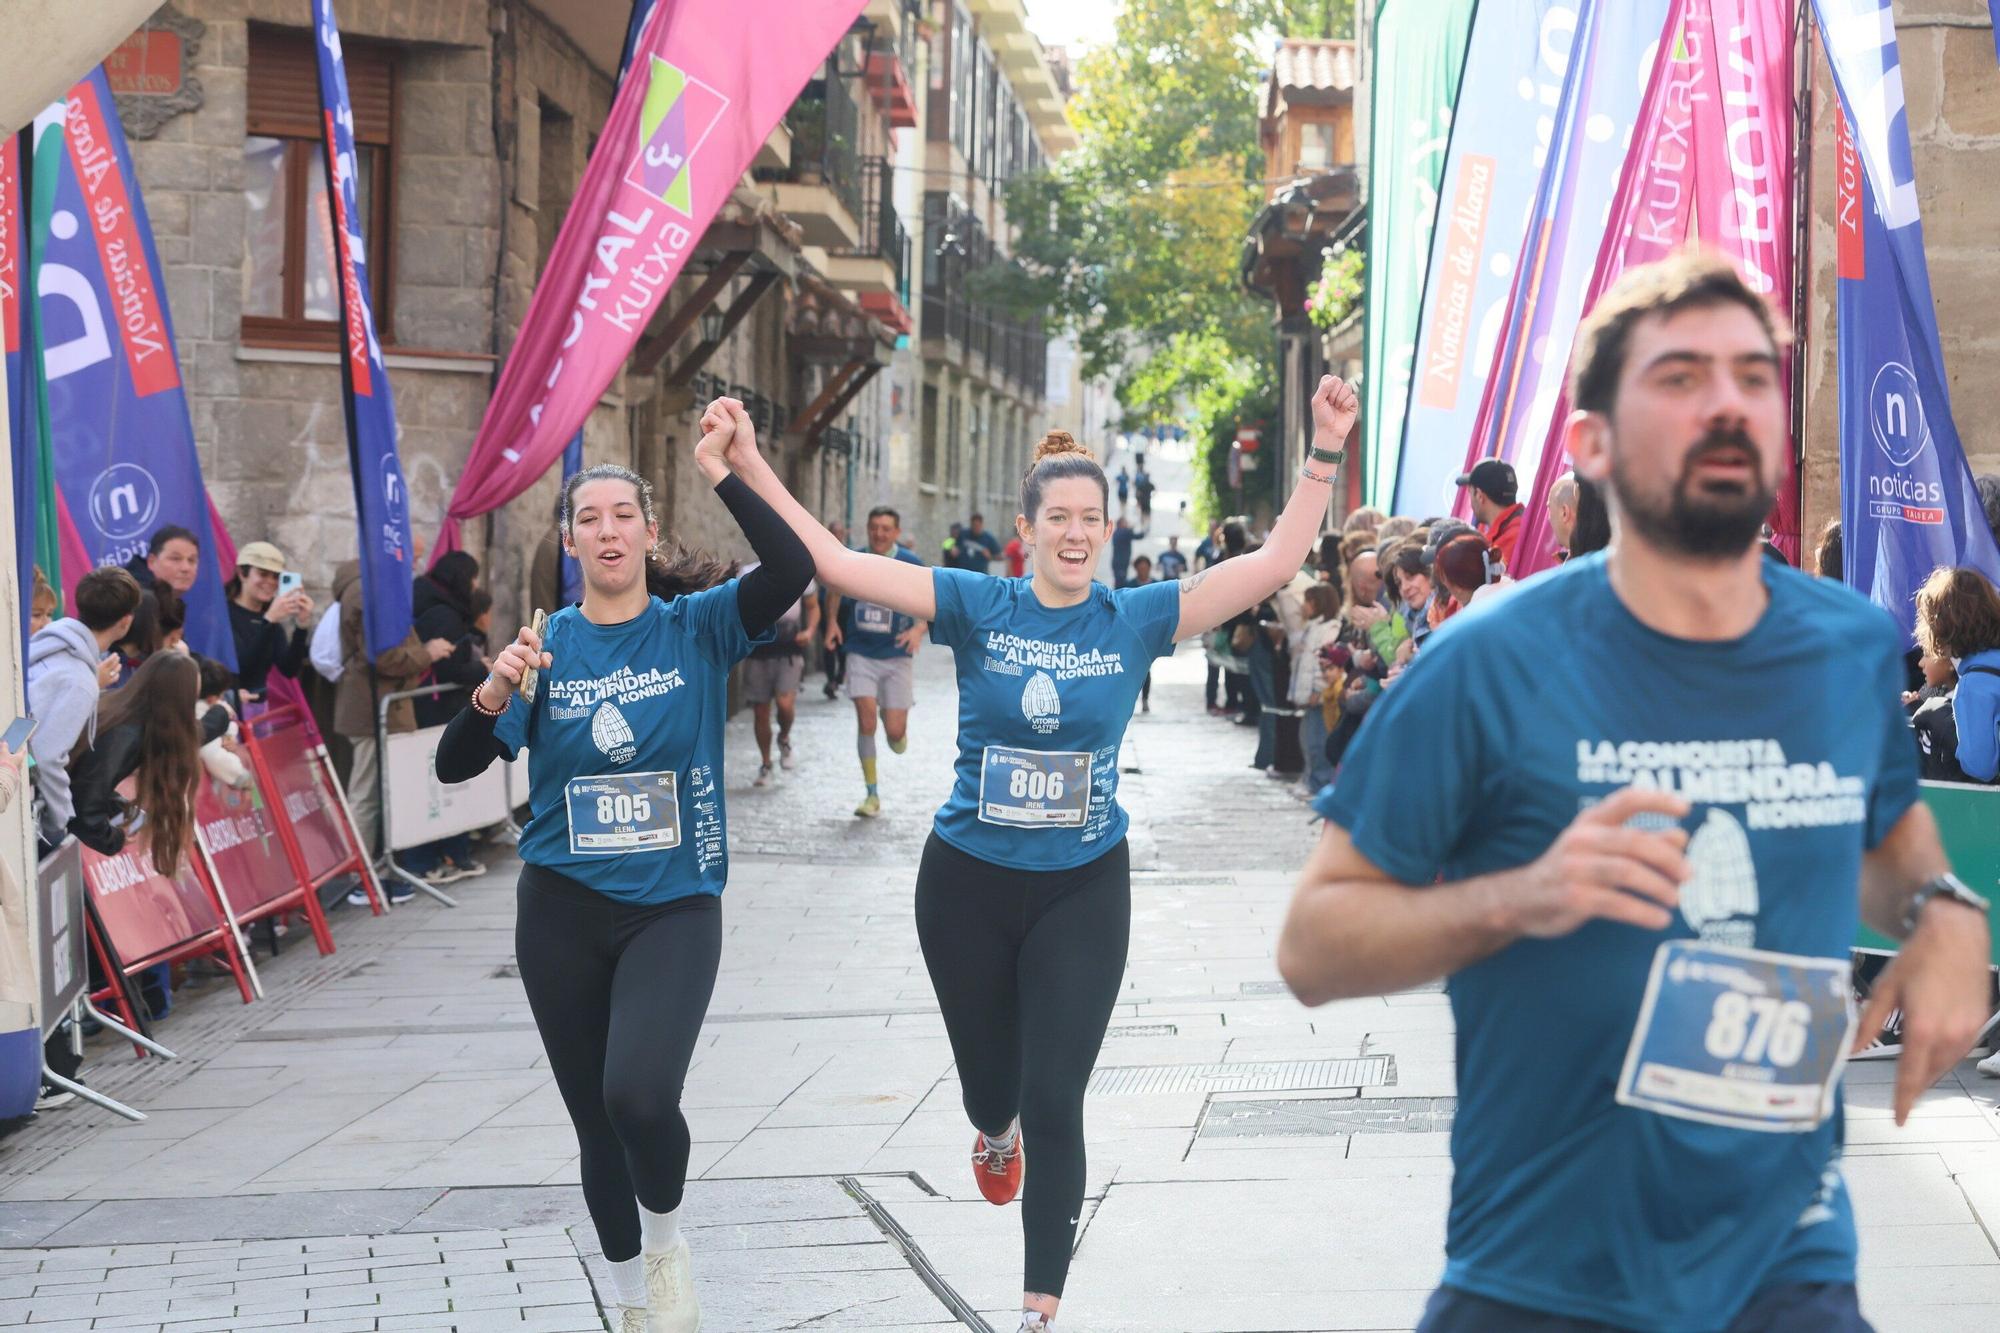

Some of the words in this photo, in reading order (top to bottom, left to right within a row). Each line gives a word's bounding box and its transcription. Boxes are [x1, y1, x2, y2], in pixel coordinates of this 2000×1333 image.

[1638, 79, 1692, 245] kutxa
[602, 221, 691, 334] kutxa
[1430, 280, 1469, 384] Noticias
[1450, 246, 1474, 276] de
[1869, 472, 1940, 502] noticias
[1876, 505, 1901, 515] GRUPO
[988, 631, 1005, 645] LA
[1005, 634, 1077, 655] CONQUISTA
[1004, 647, 1103, 670] ALMENDRA
[1056, 661, 1124, 681] KONKISTA
[549, 680, 565, 692] LA
[561, 691, 572, 699] LA
[618, 675, 685, 705] KONKISTA
[1032, 717, 1060, 725] VITORIA
[657, 777, 670, 786] 5K
[1009, 769, 1064, 800] 806
[596, 793, 650, 825] 805
[1025, 802, 1046, 810] IRENE
[89, 852, 145, 896] LABORAL
[1704, 989, 1812, 1068] 876
